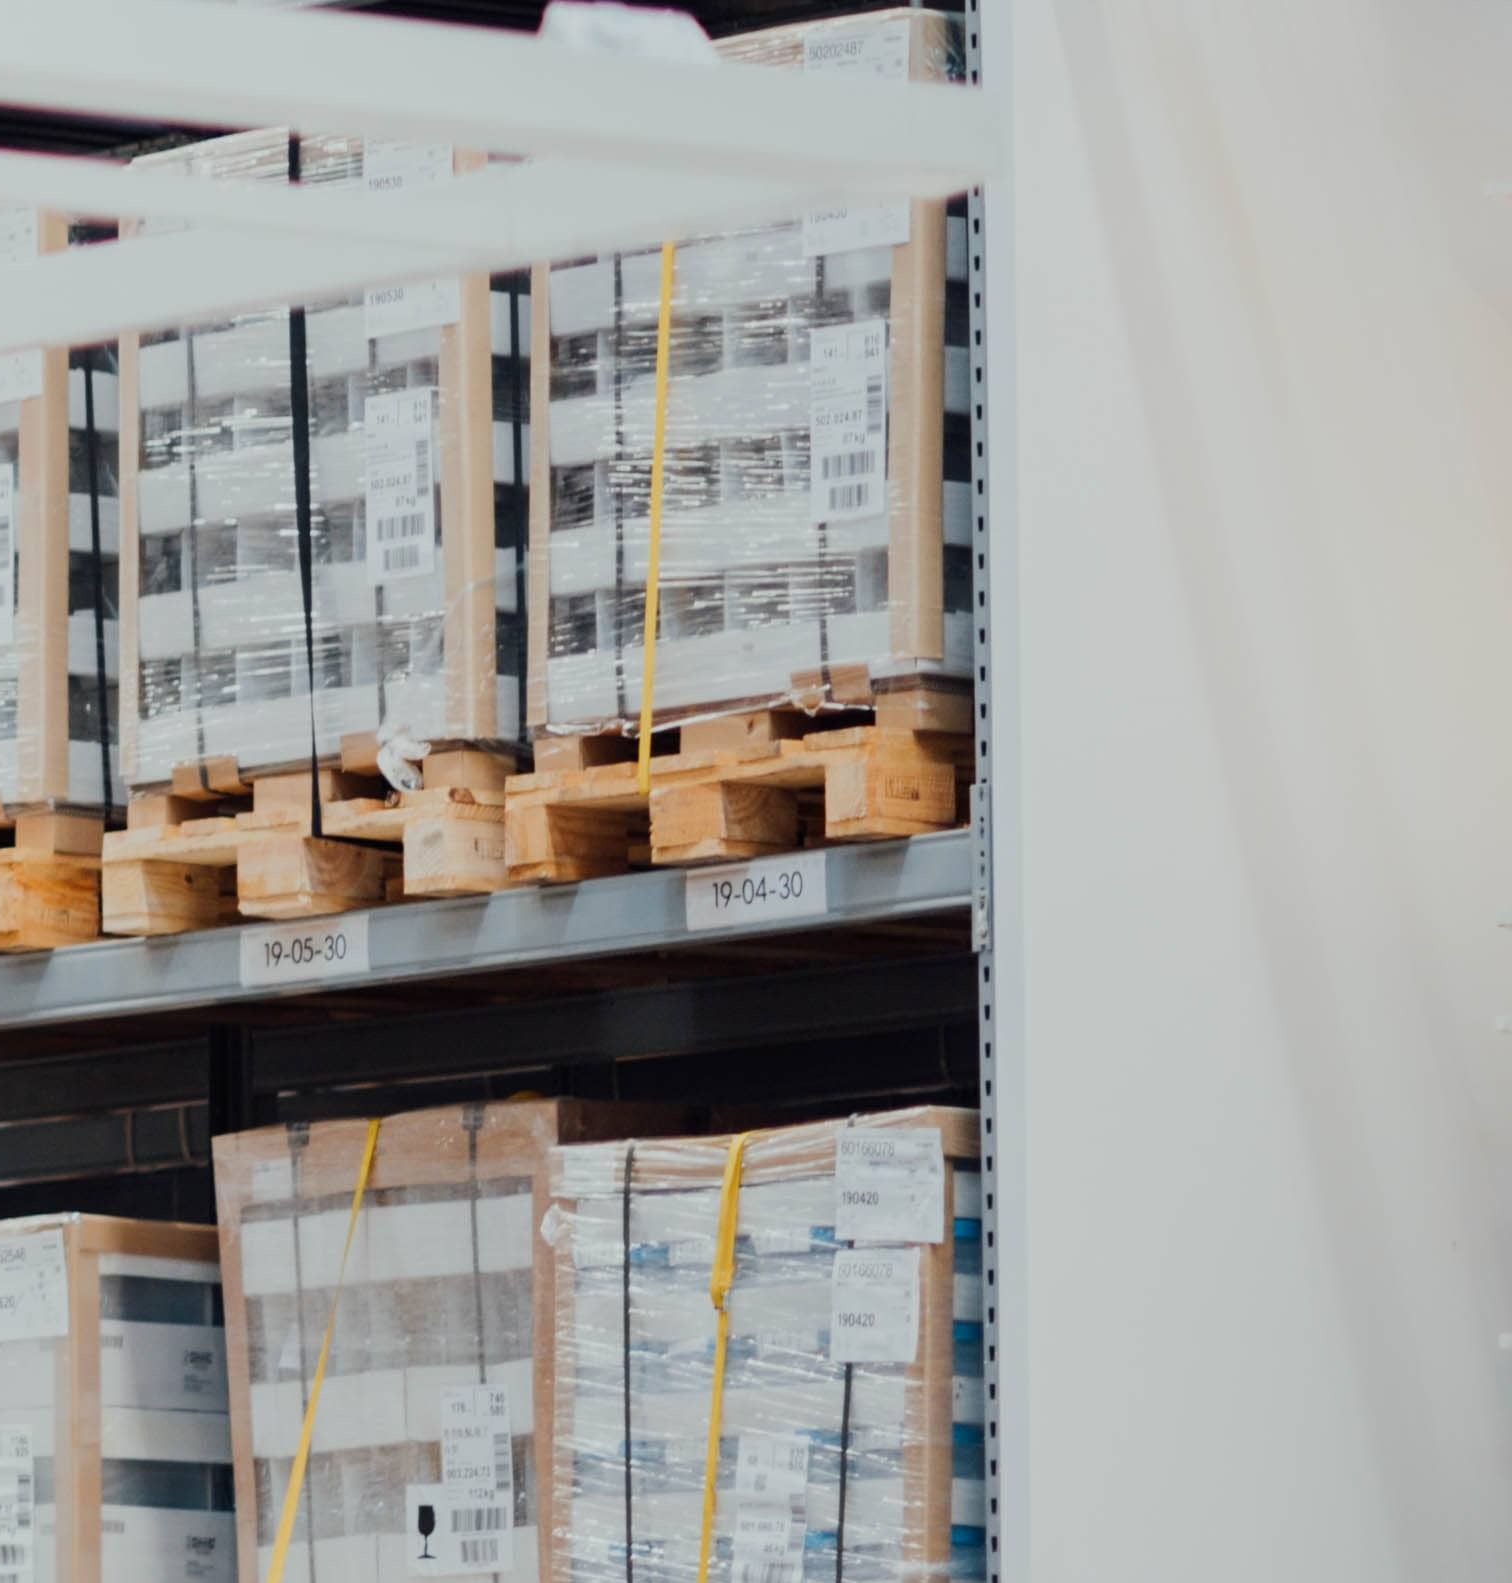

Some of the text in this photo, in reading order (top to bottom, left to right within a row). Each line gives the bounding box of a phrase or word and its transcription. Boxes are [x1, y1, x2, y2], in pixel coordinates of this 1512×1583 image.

[710, 870, 804, 909] 19-04-30
[263, 934, 348, 968] 19-05-30
[841, 1191, 880, 1206] 190420
[838, 1313, 876, 1327] 190420
